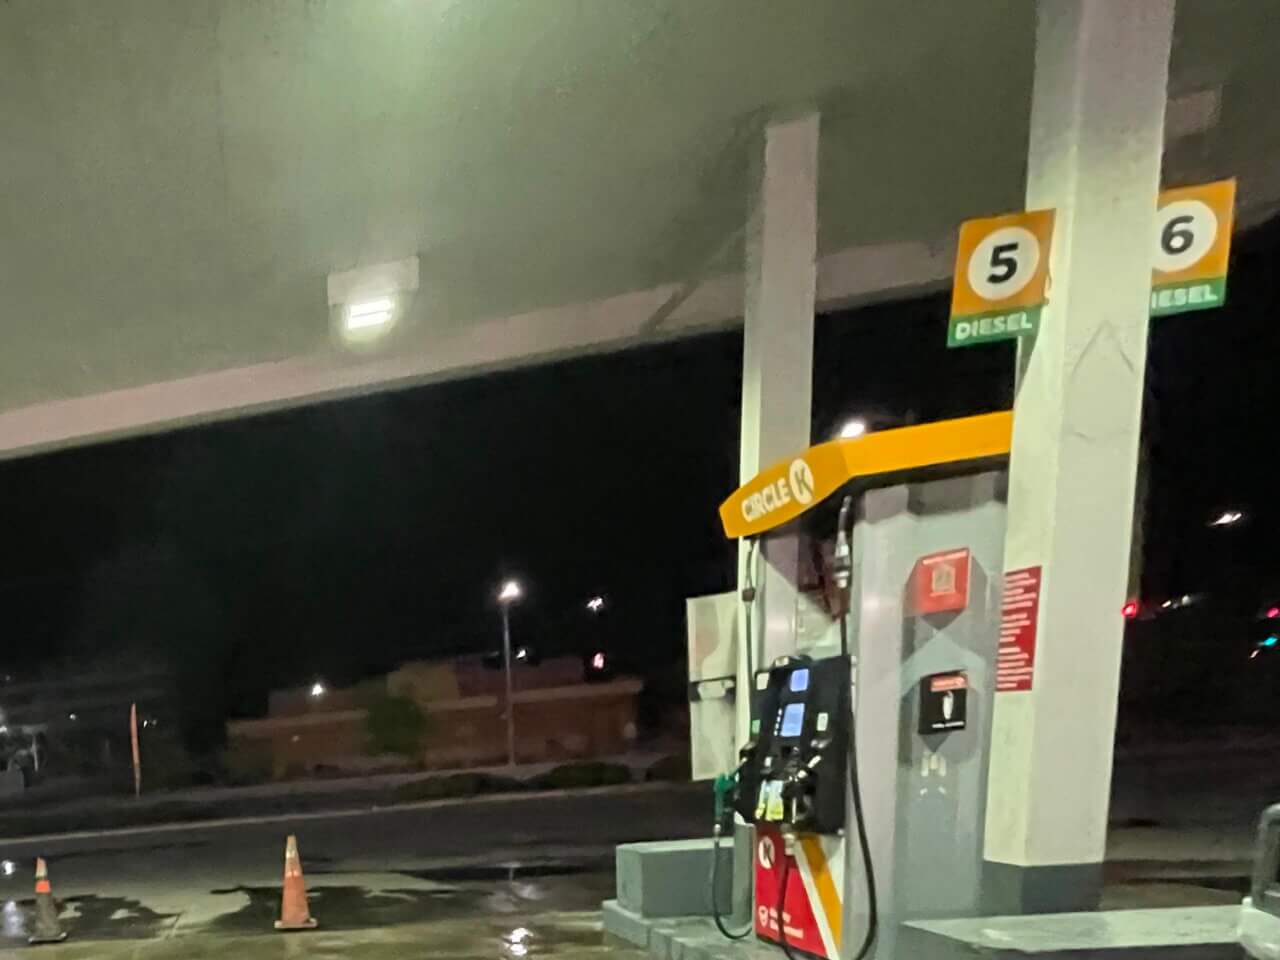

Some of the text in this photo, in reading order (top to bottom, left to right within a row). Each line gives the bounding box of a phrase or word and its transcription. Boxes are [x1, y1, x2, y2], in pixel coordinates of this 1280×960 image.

[1160, 215, 1195, 255] 6
[986, 242, 1020, 284] 5
[1151, 284, 1219, 309] IESEL
[955, 311, 1033, 340] DIESEL
[741, 462, 815, 522] CIRCLE K
[761, 839, 774, 868] K
